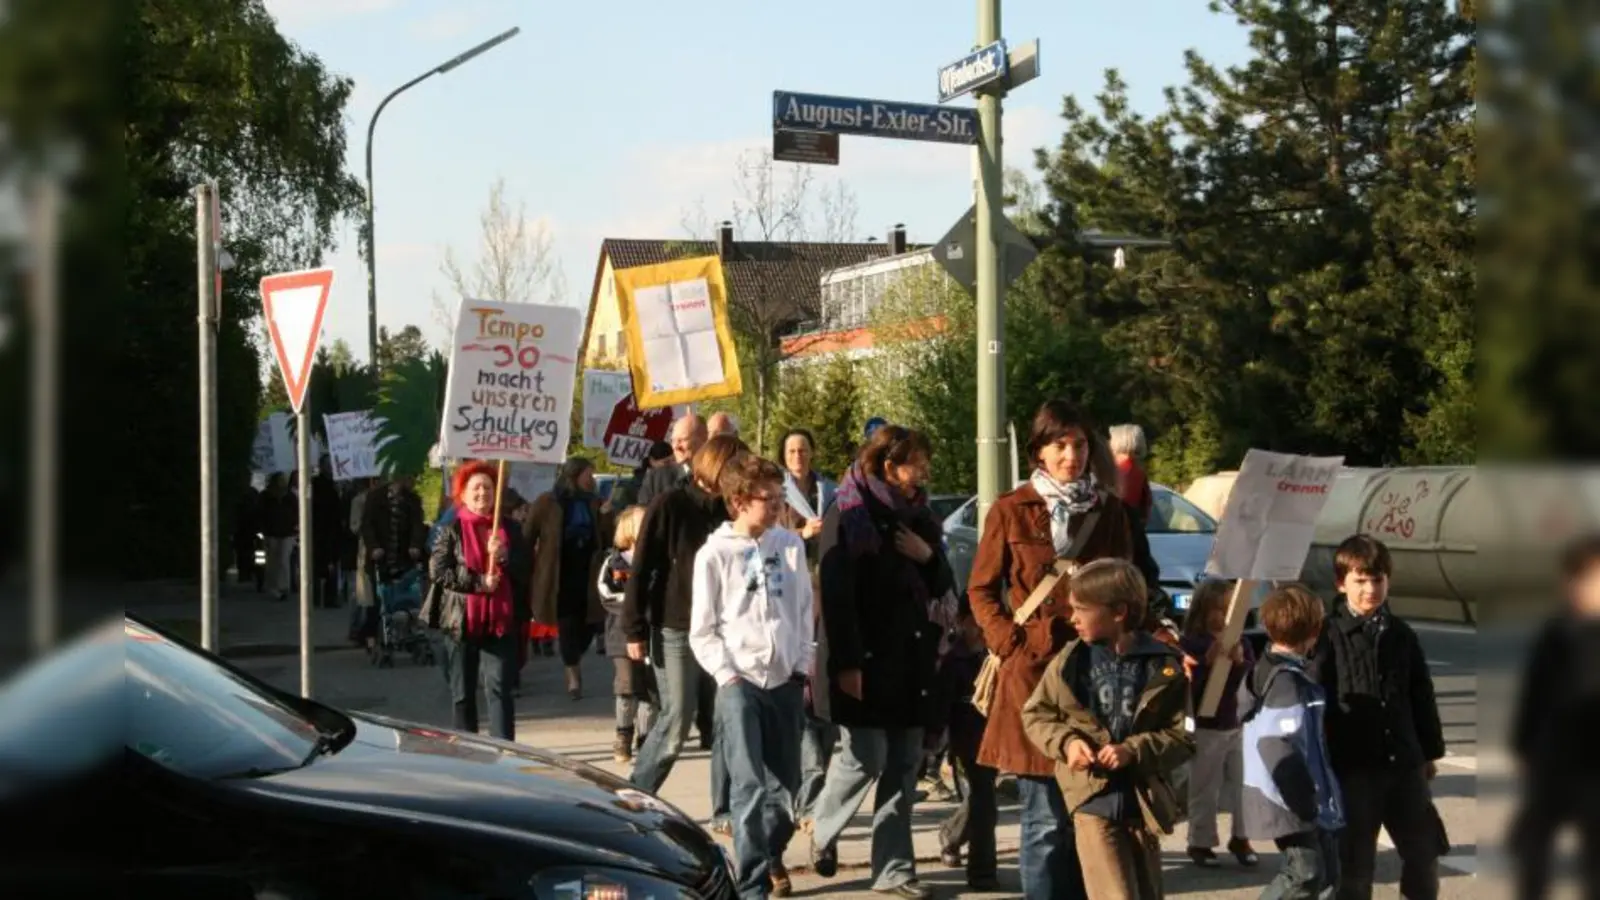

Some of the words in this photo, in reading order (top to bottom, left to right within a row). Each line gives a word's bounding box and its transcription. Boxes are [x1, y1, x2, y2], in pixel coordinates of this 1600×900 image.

[785, 97, 972, 136] August-Exter-Str.
[469, 307, 544, 350] Tempo
[477, 369, 544, 393] macht
[472, 388, 556, 412] unseren
[453, 405, 558, 451] Schulweg
[467, 433, 533, 450] SICHER
[1277, 480, 1328, 495] trennt
